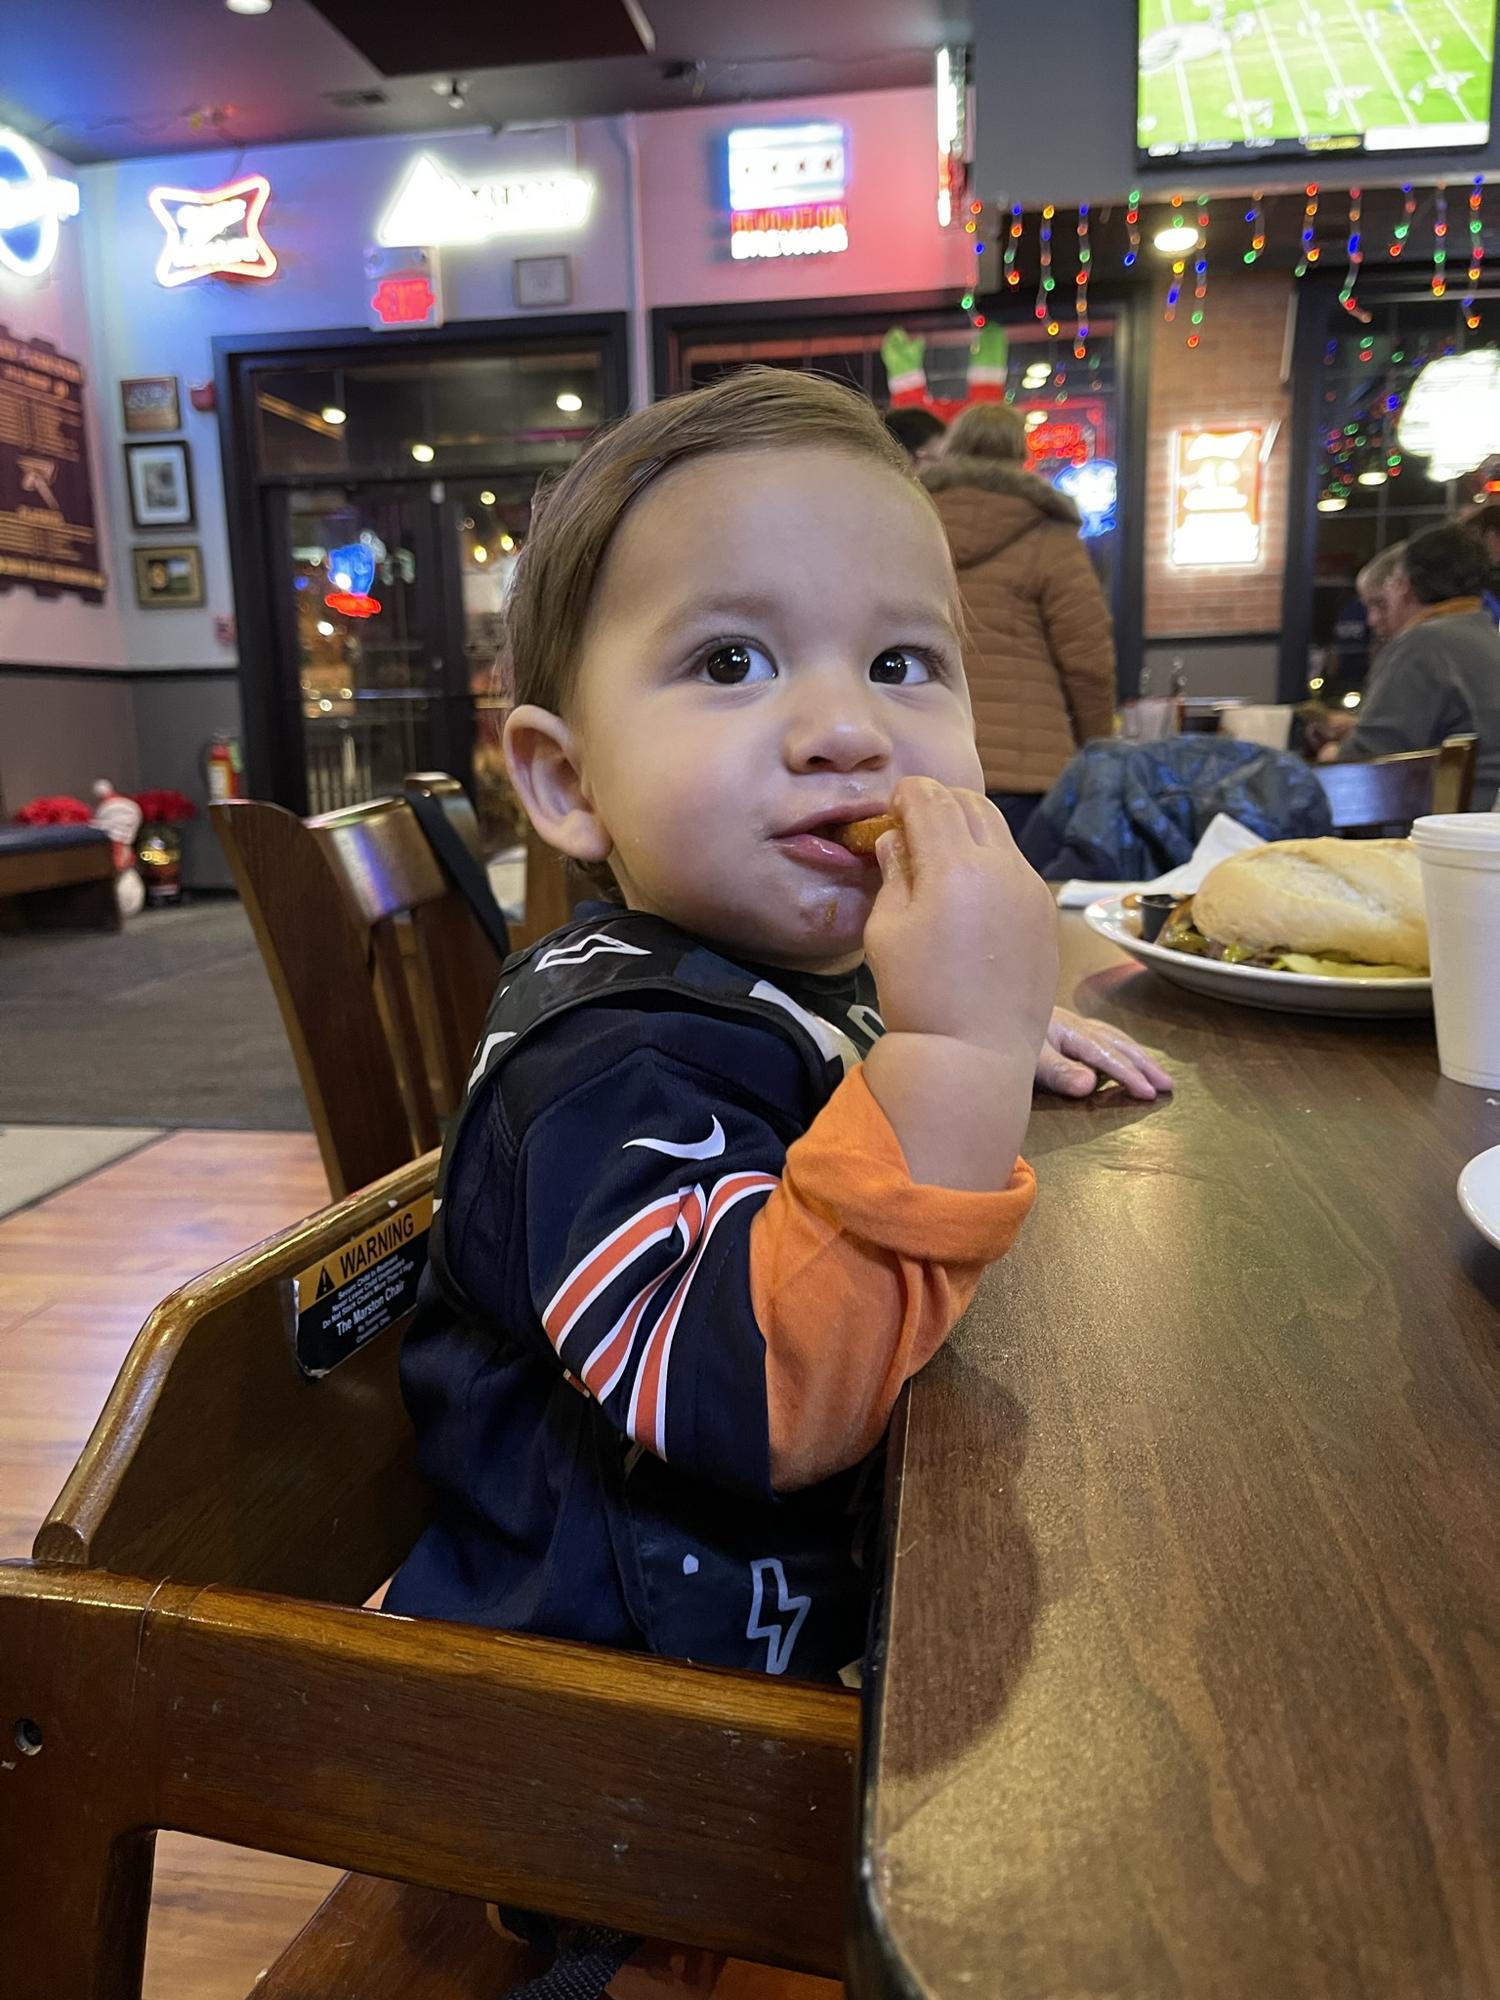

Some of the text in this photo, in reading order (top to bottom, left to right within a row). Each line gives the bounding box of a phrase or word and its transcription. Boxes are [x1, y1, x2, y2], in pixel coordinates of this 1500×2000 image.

[340, 1213, 414, 1279] WARNING
[322, 1320, 331, 1329] Do
[332, 1311, 341, 1322] Not
[336, 1319, 352, 1336] The
[353, 1296, 384, 1324] Marston
[385, 1280, 405, 1301] Chair
